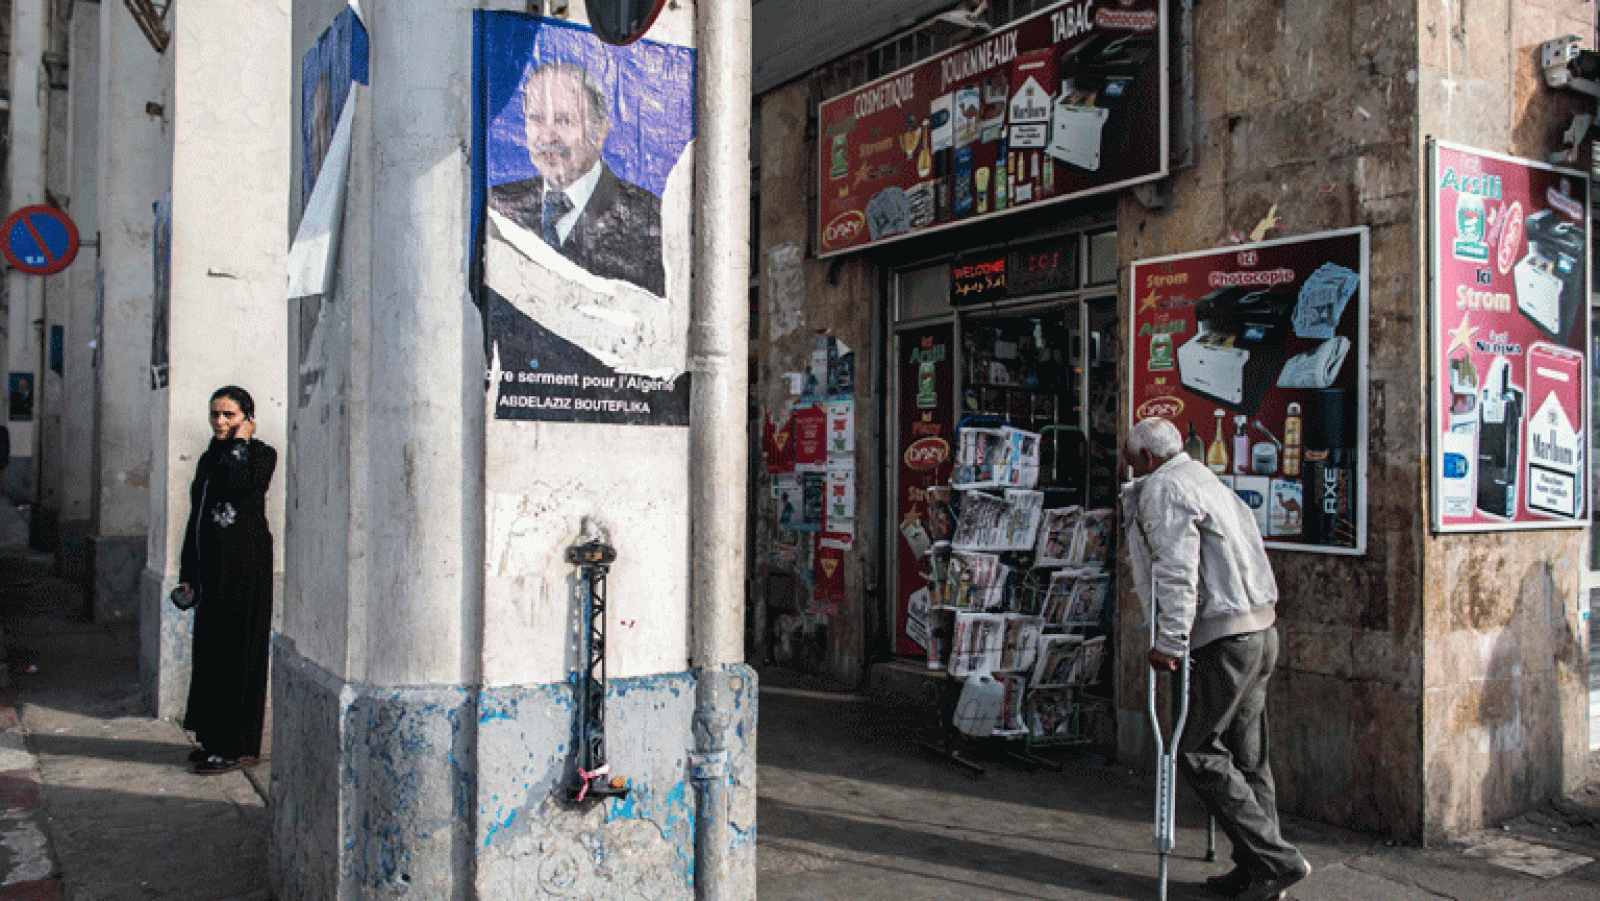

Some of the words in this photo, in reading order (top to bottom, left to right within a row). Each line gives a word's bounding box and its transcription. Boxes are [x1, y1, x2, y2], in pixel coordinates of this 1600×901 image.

[1051, 0, 1093, 44] TABAC
[953, 258, 1005, 280] WELCOME
[1207, 268, 1294, 287] Photocopie
[1455, 284, 1512, 313] Strom
[518, 371, 579, 386] serment
[582, 375, 616, 390] pour
[499, 395, 571, 410] ABDELAZIZ
[574, 398, 651, 415] BOUTEFLIKA
[1324, 467, 1339, 514] AXE
